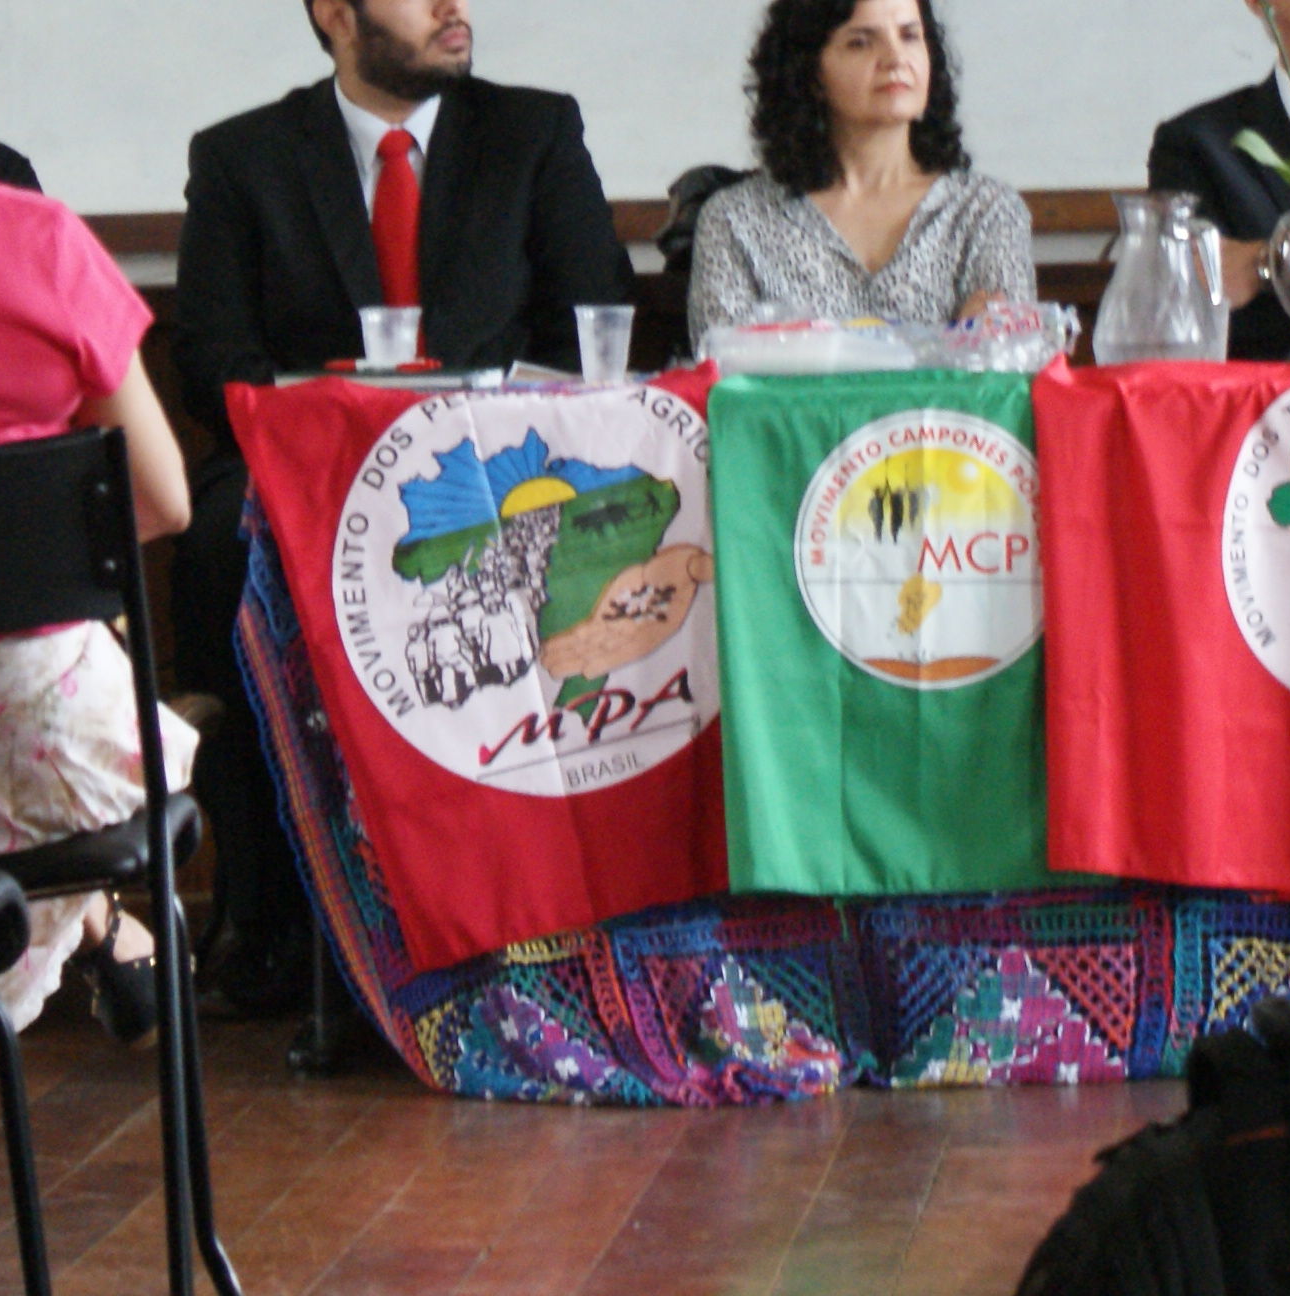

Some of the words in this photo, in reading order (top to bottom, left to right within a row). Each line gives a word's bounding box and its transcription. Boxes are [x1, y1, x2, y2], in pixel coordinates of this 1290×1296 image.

[361, 429, 413, 492] DOS
[1243, 426, 1280, 479] DOS
[810, 439, 883, 567] MOVIMENTO
[917, 531, 1030, 574] MCP
[1229, 493, 1277, 650] MOVIMENTO
[341, 512, 416, 719] MOVIMENTO
[477, 666, 694, 767] MPA
[566, 752, 645, 789] BRASIL
